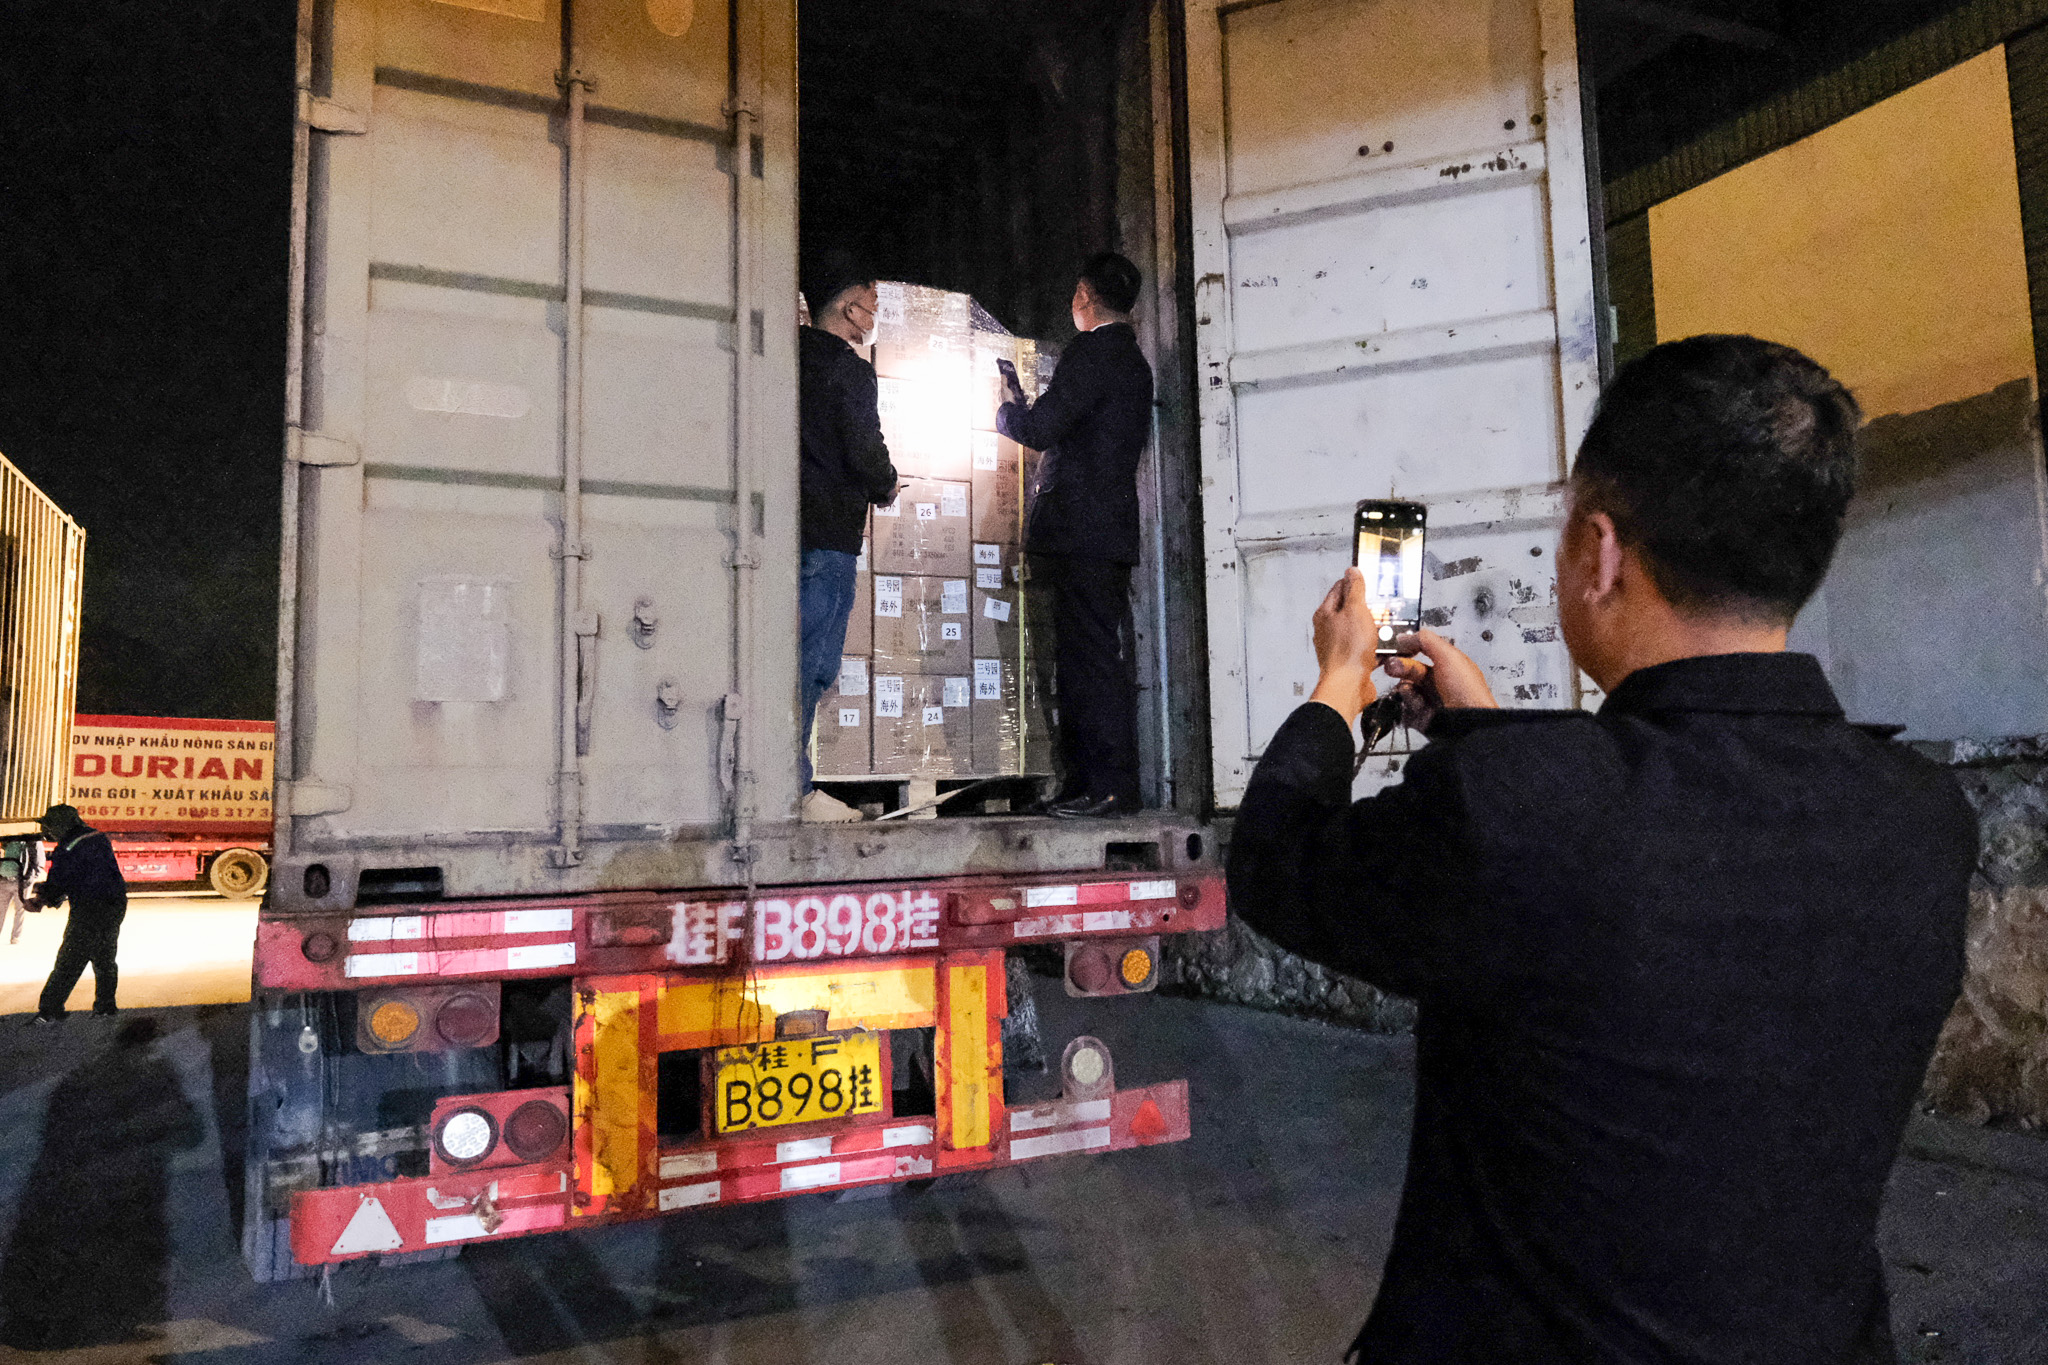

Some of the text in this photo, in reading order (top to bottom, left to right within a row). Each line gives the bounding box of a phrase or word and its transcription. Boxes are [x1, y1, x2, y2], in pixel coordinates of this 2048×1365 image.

[920, 508, 932, 517] 26
[979, 549, 996, 560] 海外
[977, 573, 1000, 584] 三号园
[878, 579, 900, 593] 三号园
[880, 600, 898, 614] 海外
[945, 627, 957, 637] 25
[976, 662, 998, 676] 三号园
[878, 679, 901, 694] 三号园
[979, 682, 997, 696] 海外
[880, 699, 899, 713] 海外
[843, 713, 855, 723] 17
[927, 712, 939, 722] 24
[73, 753, 264, 781] DURIAN
[726, 1064, 873, 1127] B898挂
